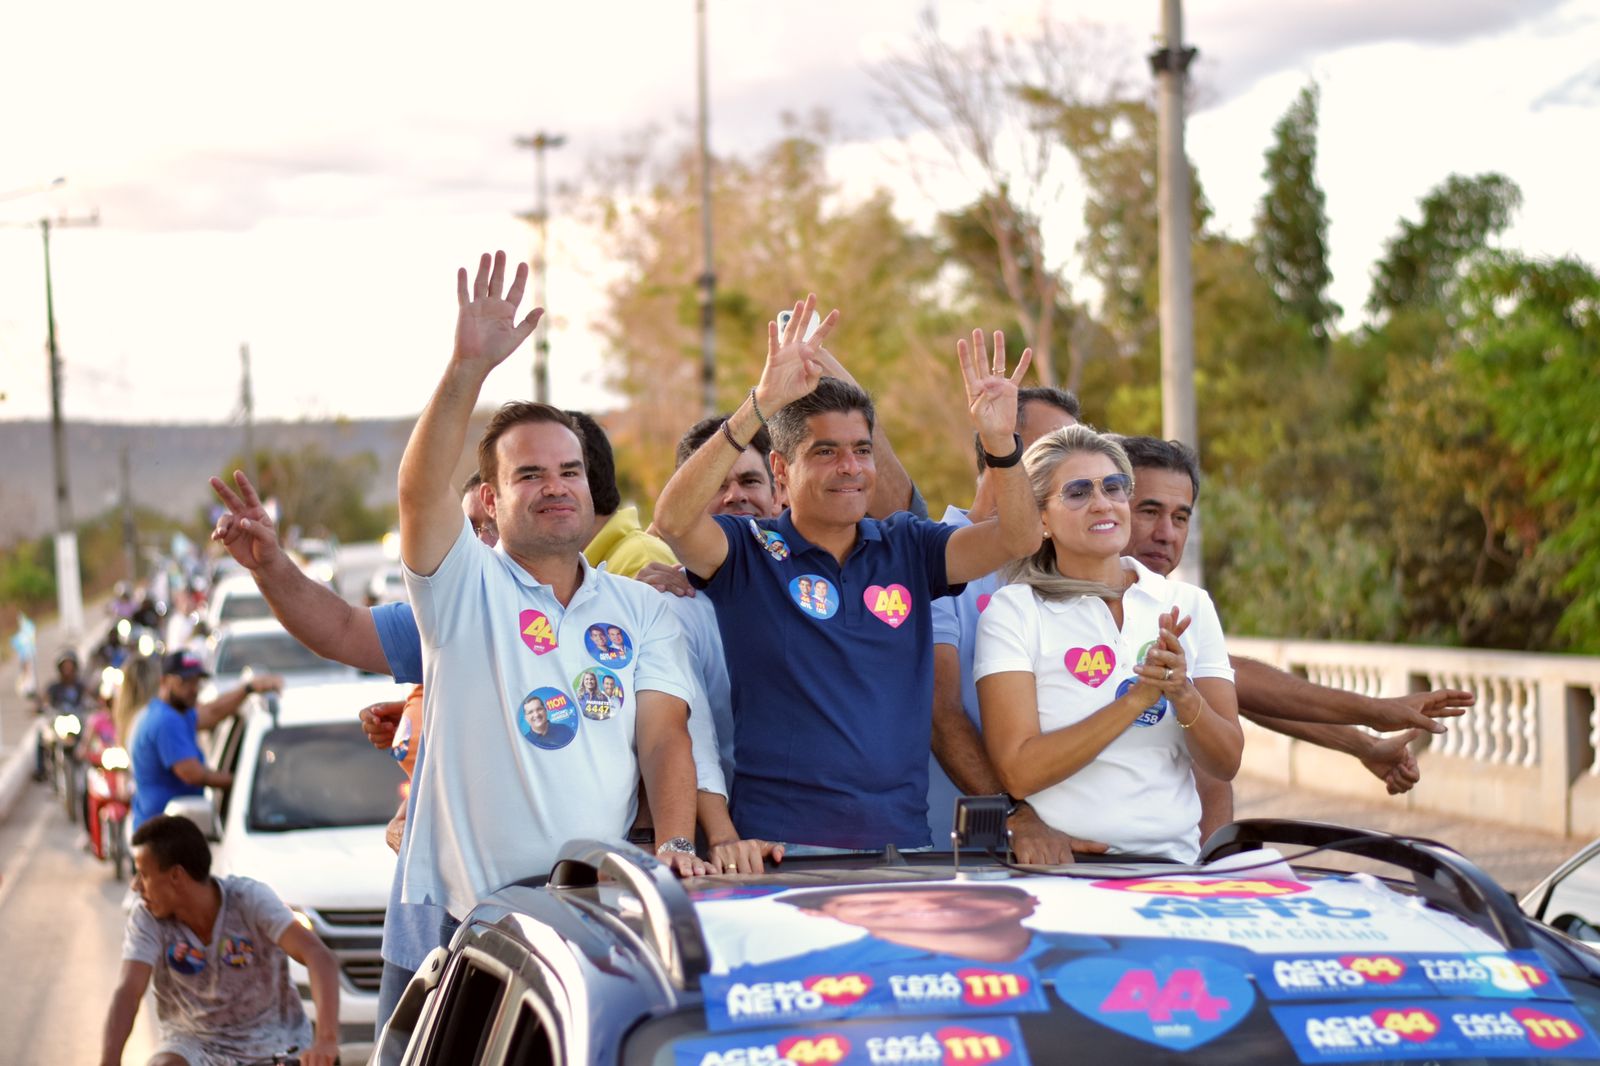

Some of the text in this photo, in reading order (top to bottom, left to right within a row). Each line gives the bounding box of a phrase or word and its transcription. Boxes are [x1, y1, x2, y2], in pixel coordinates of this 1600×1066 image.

[874, 589, 908, 616] 44
[523, 616, 556, 645] 44
[1074, 650, 1111, 677] 44
[585, 704, 609, 714] 4447
[1124, 880, 1295, 894] 44
[1132, 905, 1372, 920] NETO
[1350, 958, 1402, 976] 44
[810, 975, 868, 996] 44
[963, 974, 1020, 997] 111
[1100, 969, 1230, 1021] 44
[1382, 1011, 1436, 1034] 44
[1522, 1018, 1579, 1038] 111
[786, 1037, 843, 1064] 44
[944, 1035, 1003, 1060] 111
